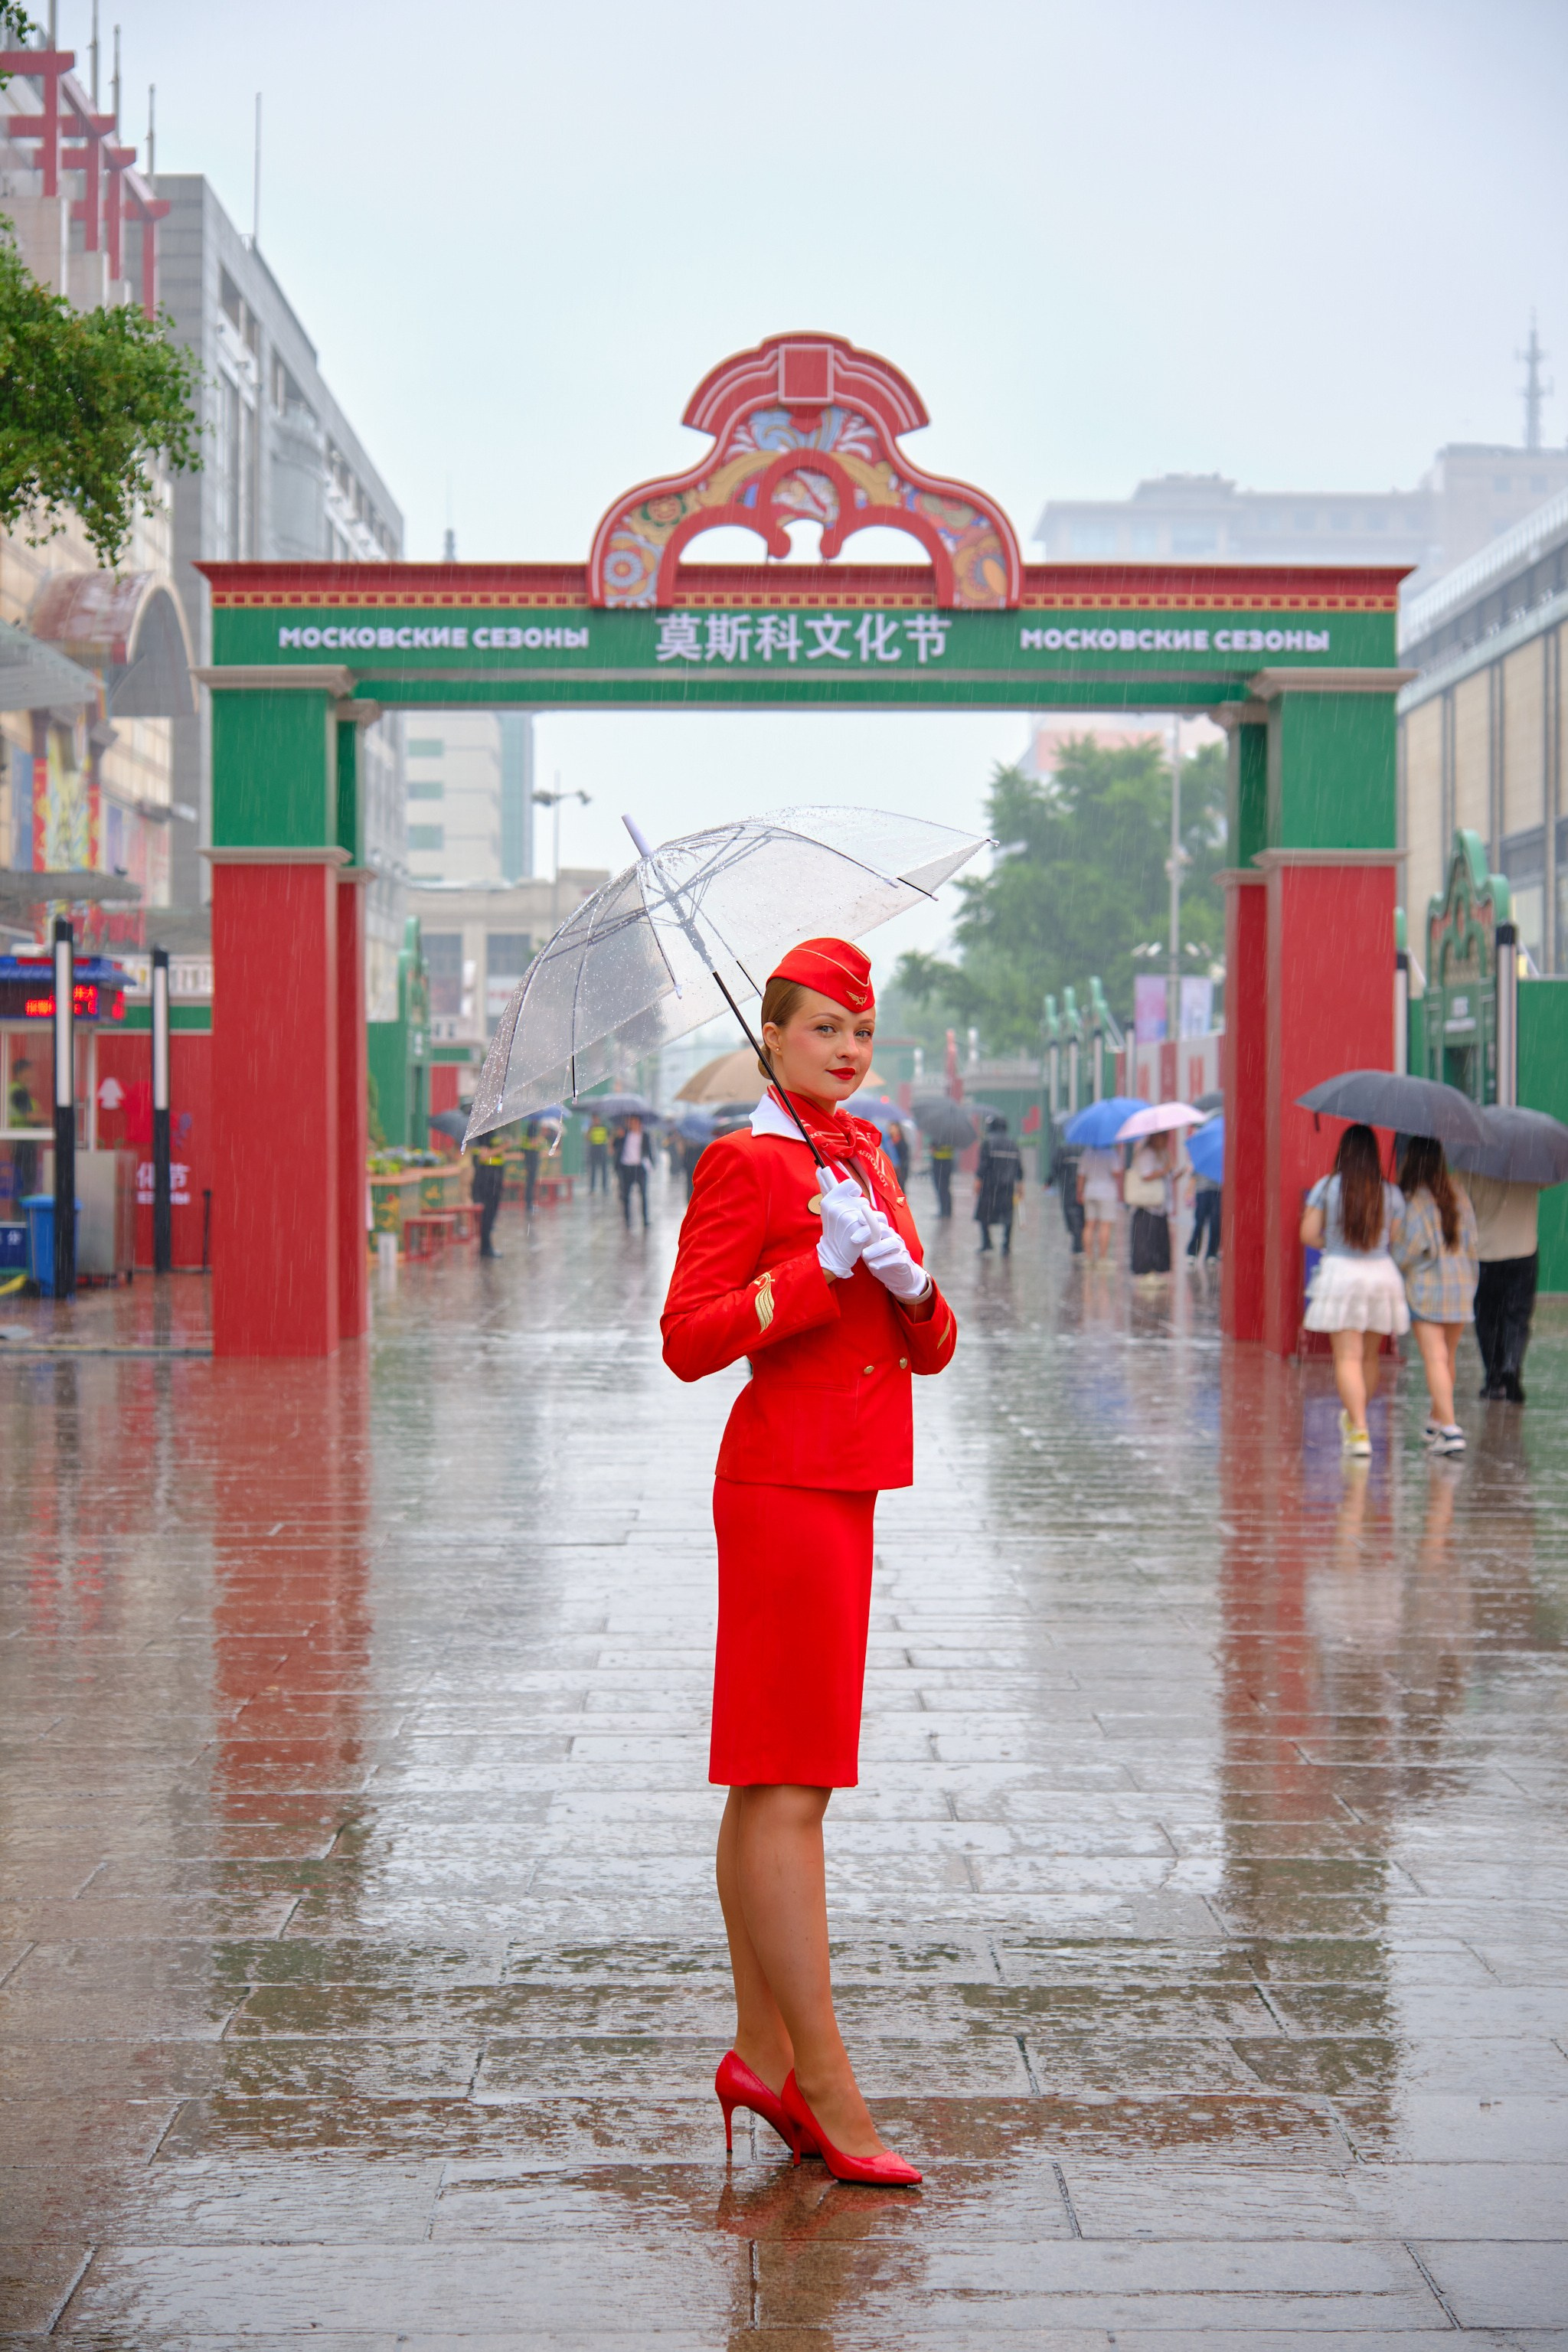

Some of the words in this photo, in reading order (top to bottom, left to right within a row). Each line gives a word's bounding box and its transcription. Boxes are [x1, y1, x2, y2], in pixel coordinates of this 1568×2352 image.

[279, 626, 467, 649] МОСКОВСКИЕ
[473, 627, 590, 649] СЕЗОНЫ
[655, 613, 952, 663] 莫斯科文化节
[1020, 629, 1210, 651] МОСКОВСКИЕ
[1214, 629, 1330, 651] СЕЗОНЫ
